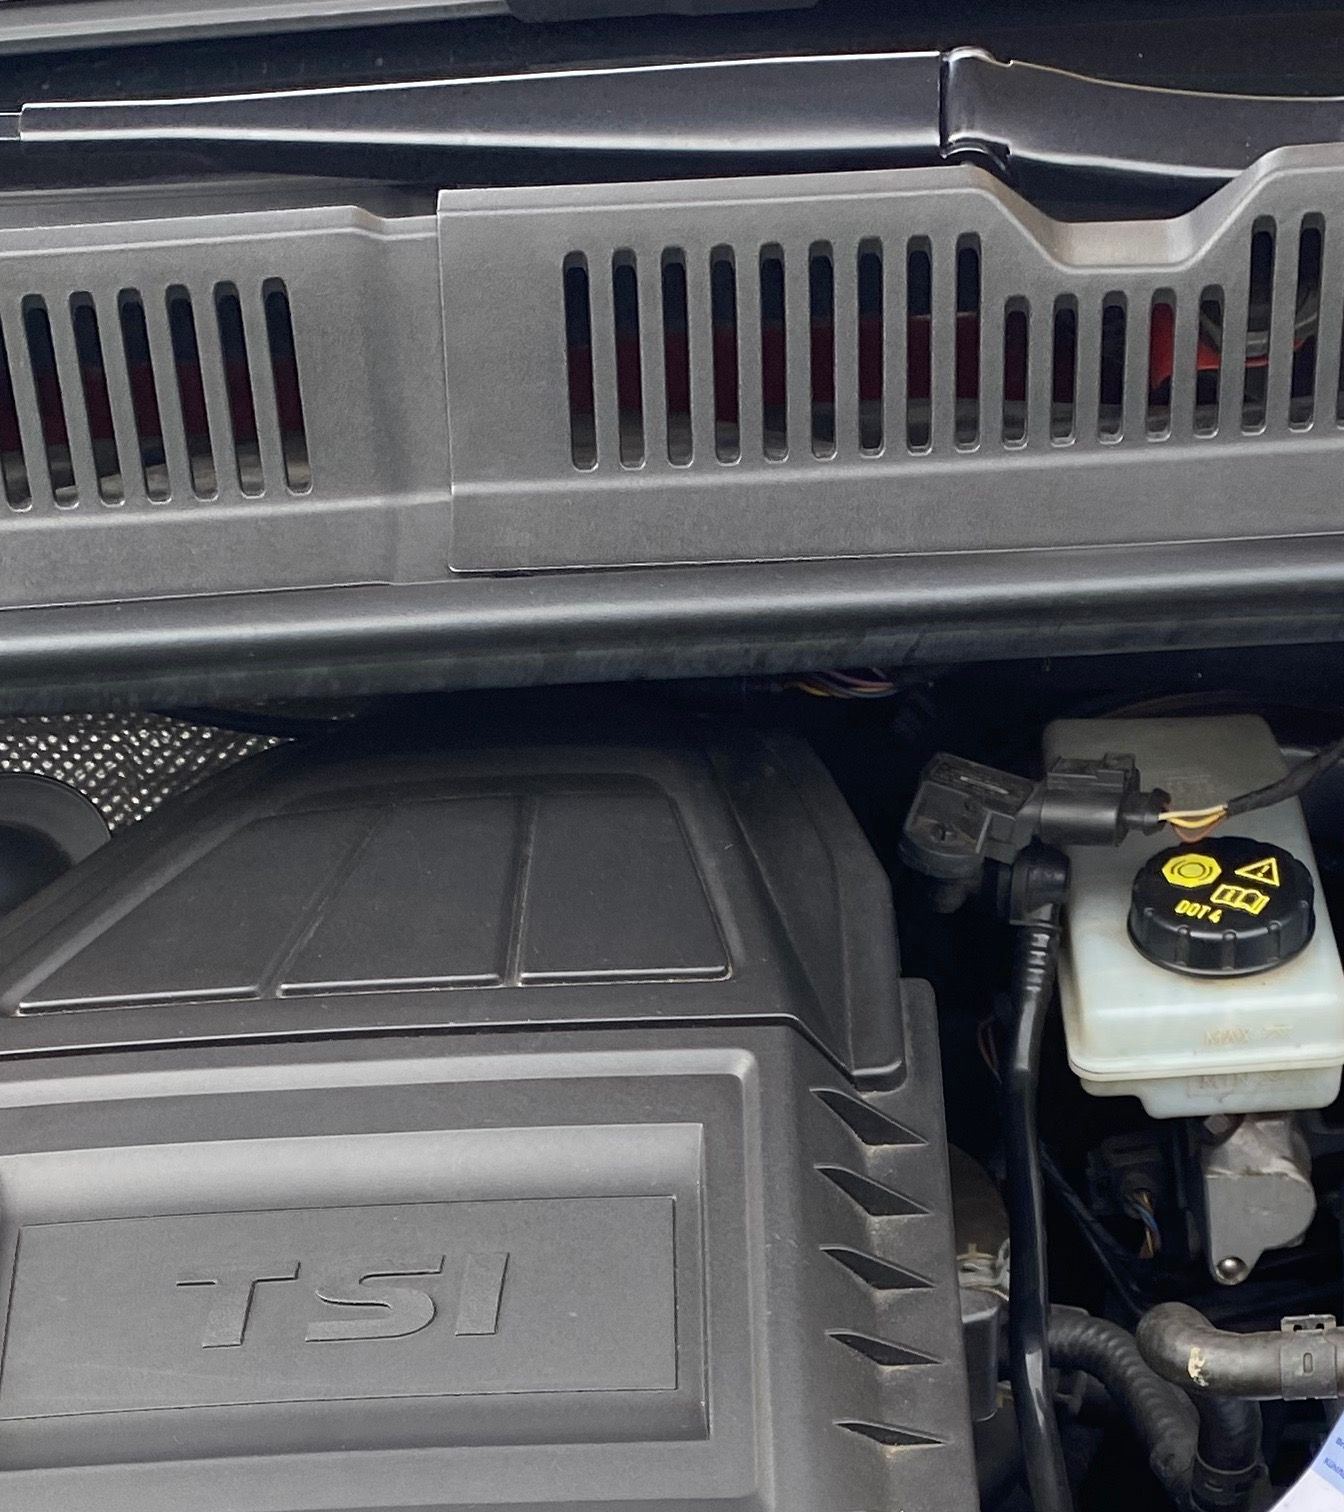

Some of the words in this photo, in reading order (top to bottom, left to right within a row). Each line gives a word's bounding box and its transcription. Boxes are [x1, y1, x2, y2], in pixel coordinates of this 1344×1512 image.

[1174, 899, 1210, 919] DOT
[1208, 909, 1223, 924] 4
[175, 1250, 511, 1350] TSI
